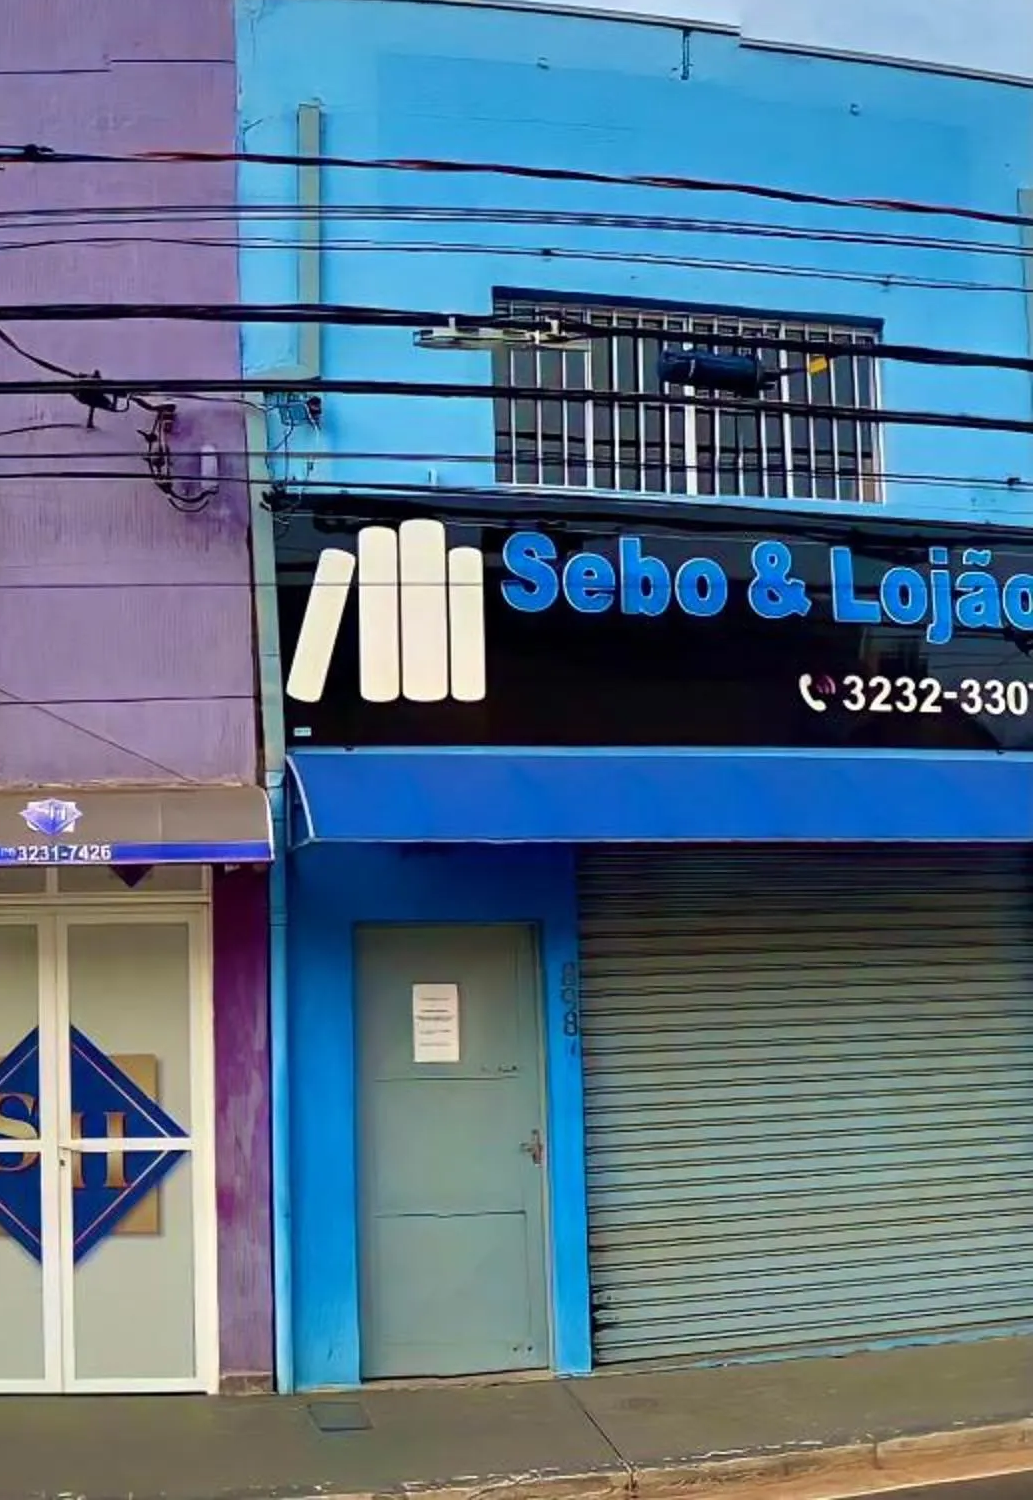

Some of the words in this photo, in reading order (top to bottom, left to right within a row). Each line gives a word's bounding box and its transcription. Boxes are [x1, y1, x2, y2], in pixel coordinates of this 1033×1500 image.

[501, 531, 729, 617] Sebo
[748, 540, 813, 619] &
[830, 546, 1033, 645] Lojão
[842, 674, 1033, 716] 3232-330
[17, 845, 112, 861] 3231-7426
